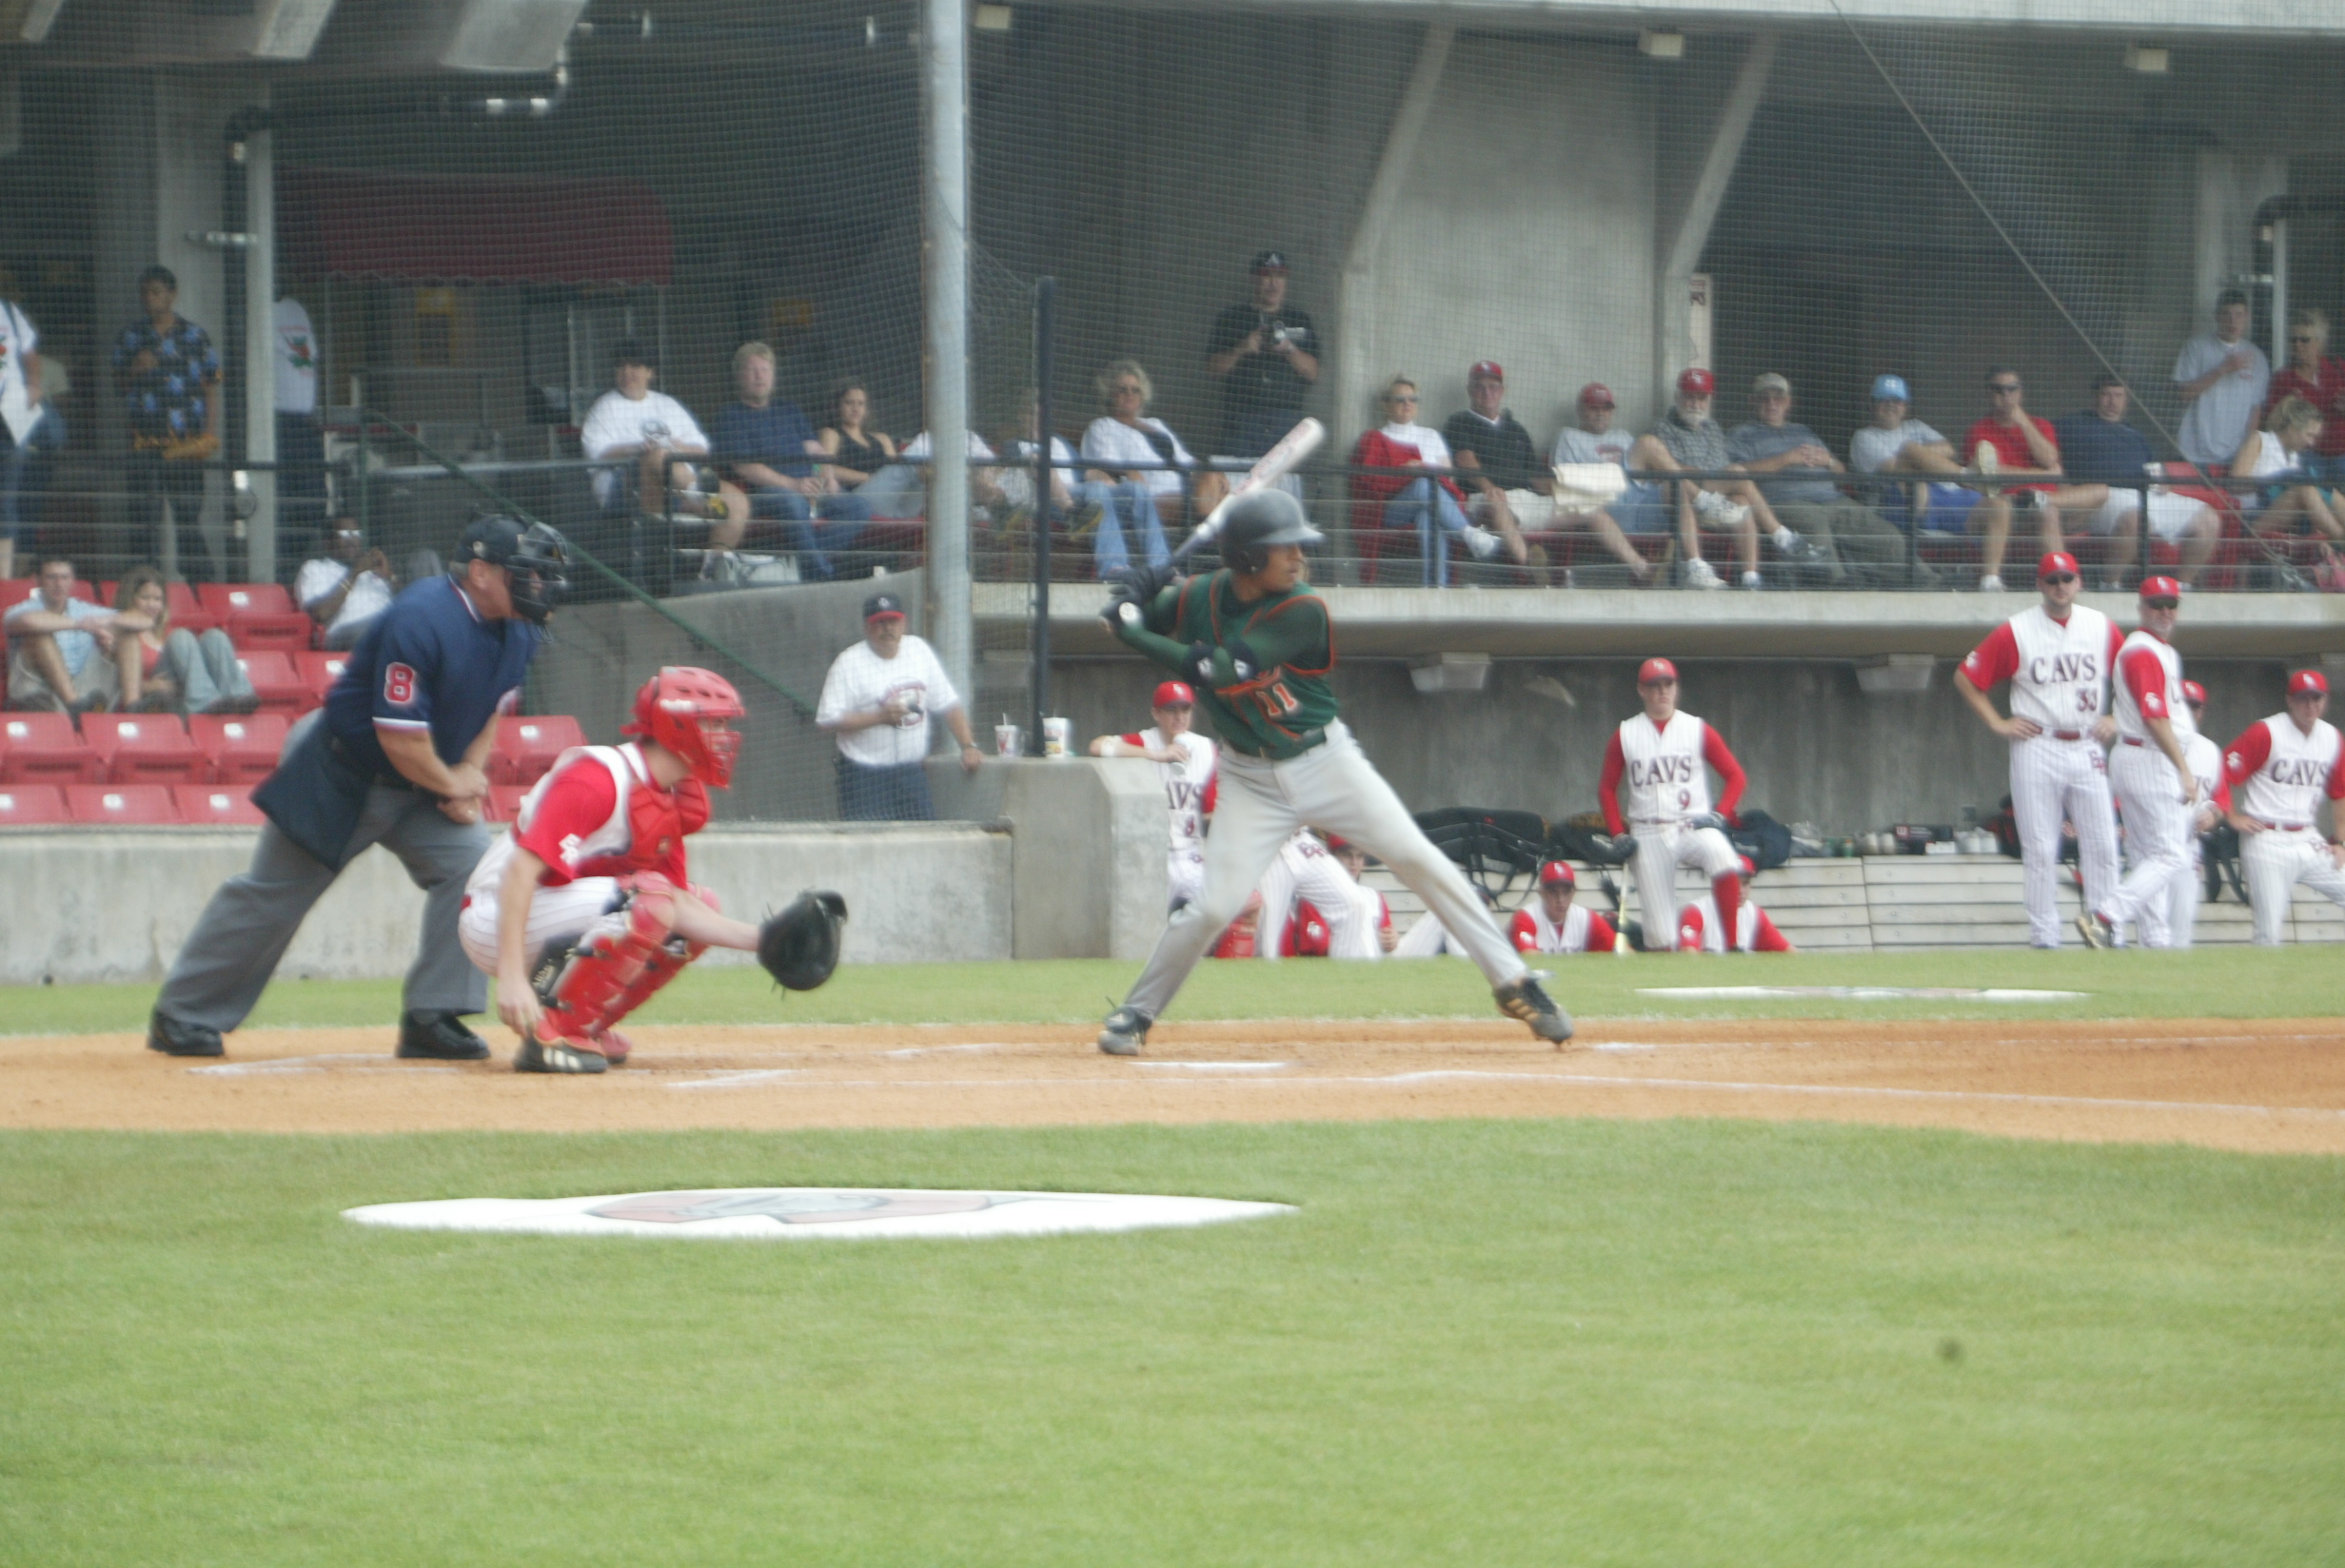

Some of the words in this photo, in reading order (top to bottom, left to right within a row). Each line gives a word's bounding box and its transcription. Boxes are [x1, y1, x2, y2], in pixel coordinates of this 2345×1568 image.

[383, 661, 417, 707] 8
[2030, 653, 2097, 685] CAVS
[1255, 682, 1299, 716] 11
[1630, 754, 1692, 789] CAVS
[1677, 788, 1691, 813] 9
